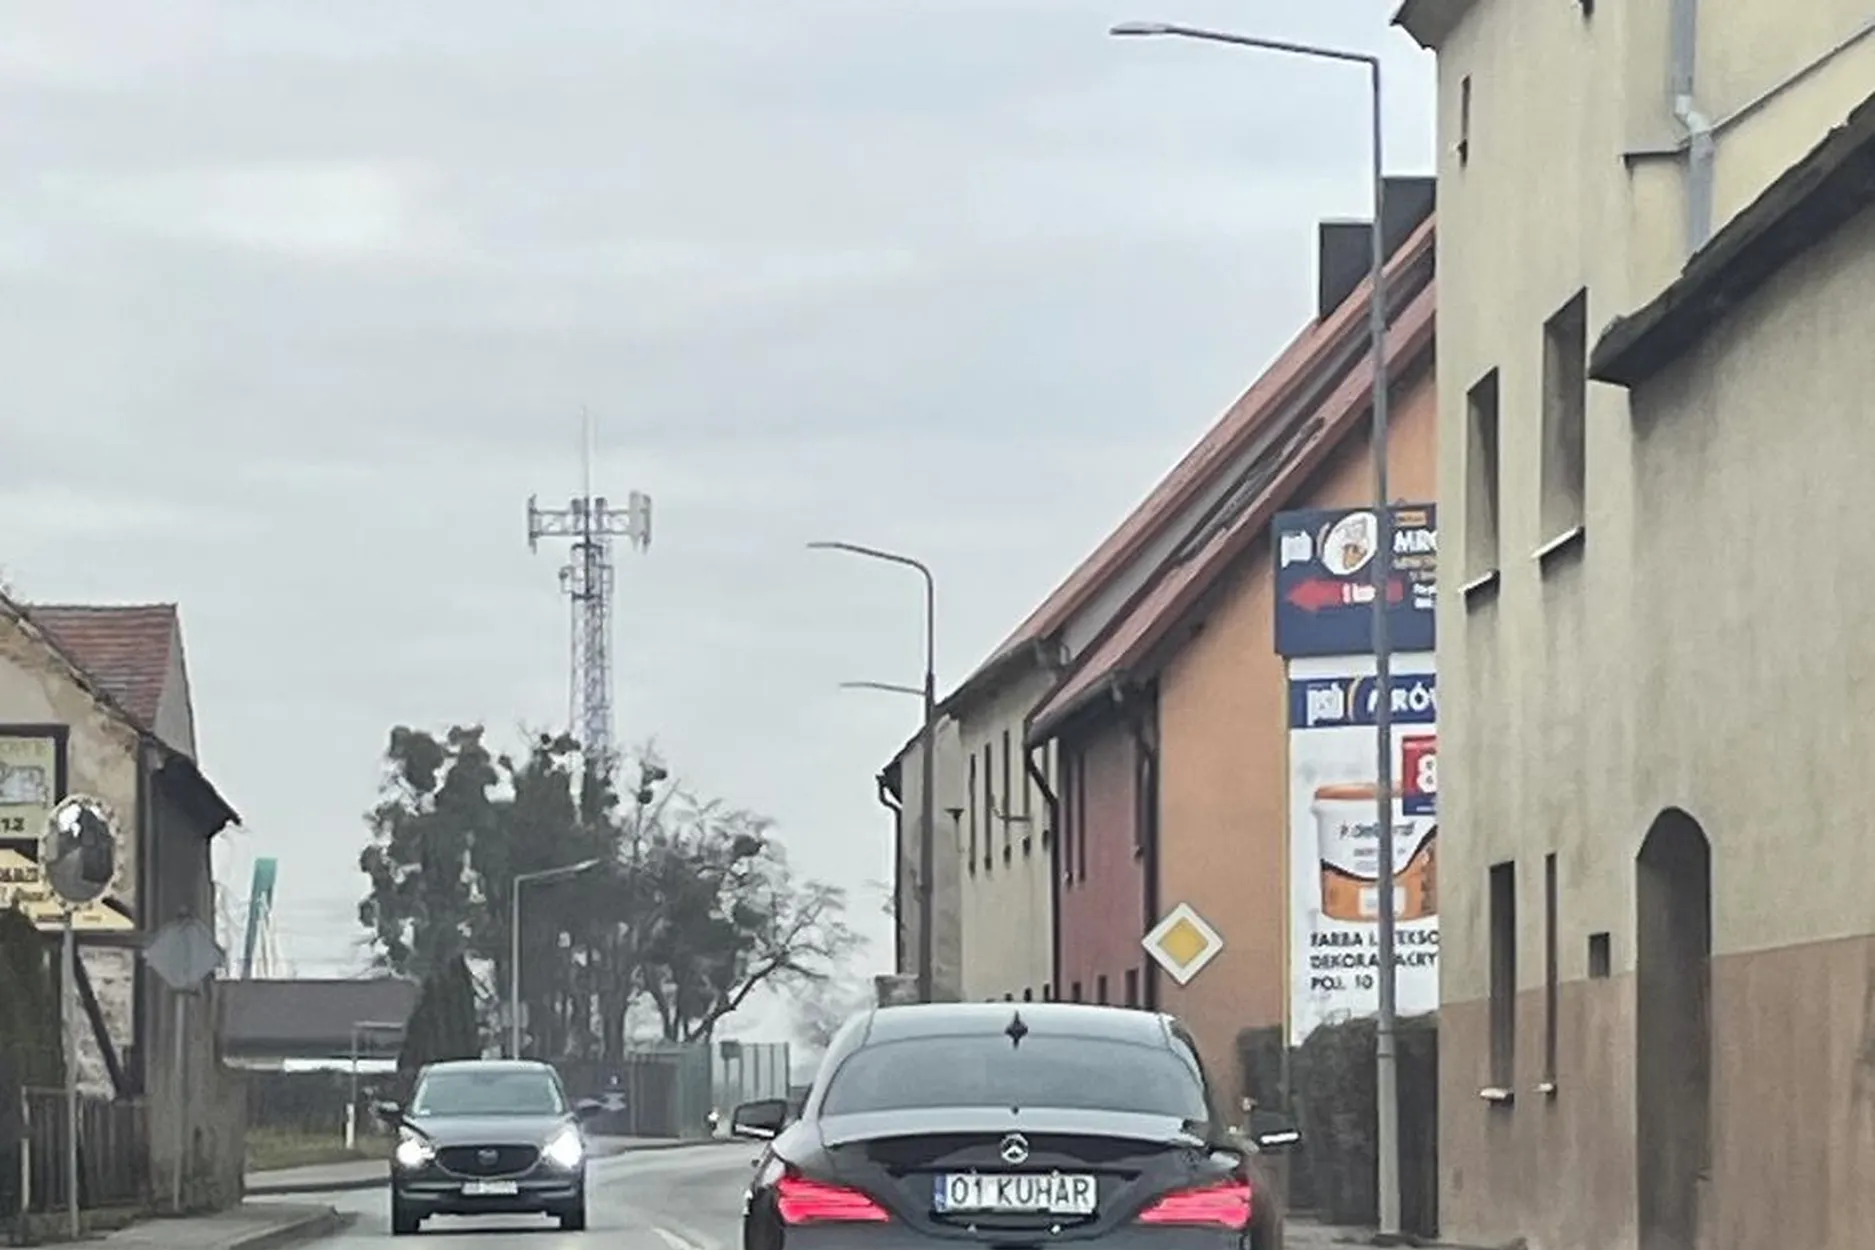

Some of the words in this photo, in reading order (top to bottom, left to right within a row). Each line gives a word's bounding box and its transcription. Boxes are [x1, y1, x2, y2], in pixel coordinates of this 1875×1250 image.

[1367, 681, 1436, 713] RÓ
[1369, 930, 1440, 946] LEKSO
[1310, 953, 1385, 968] DEKORA
[997, 1176, 1090, 1206] KUHAR
